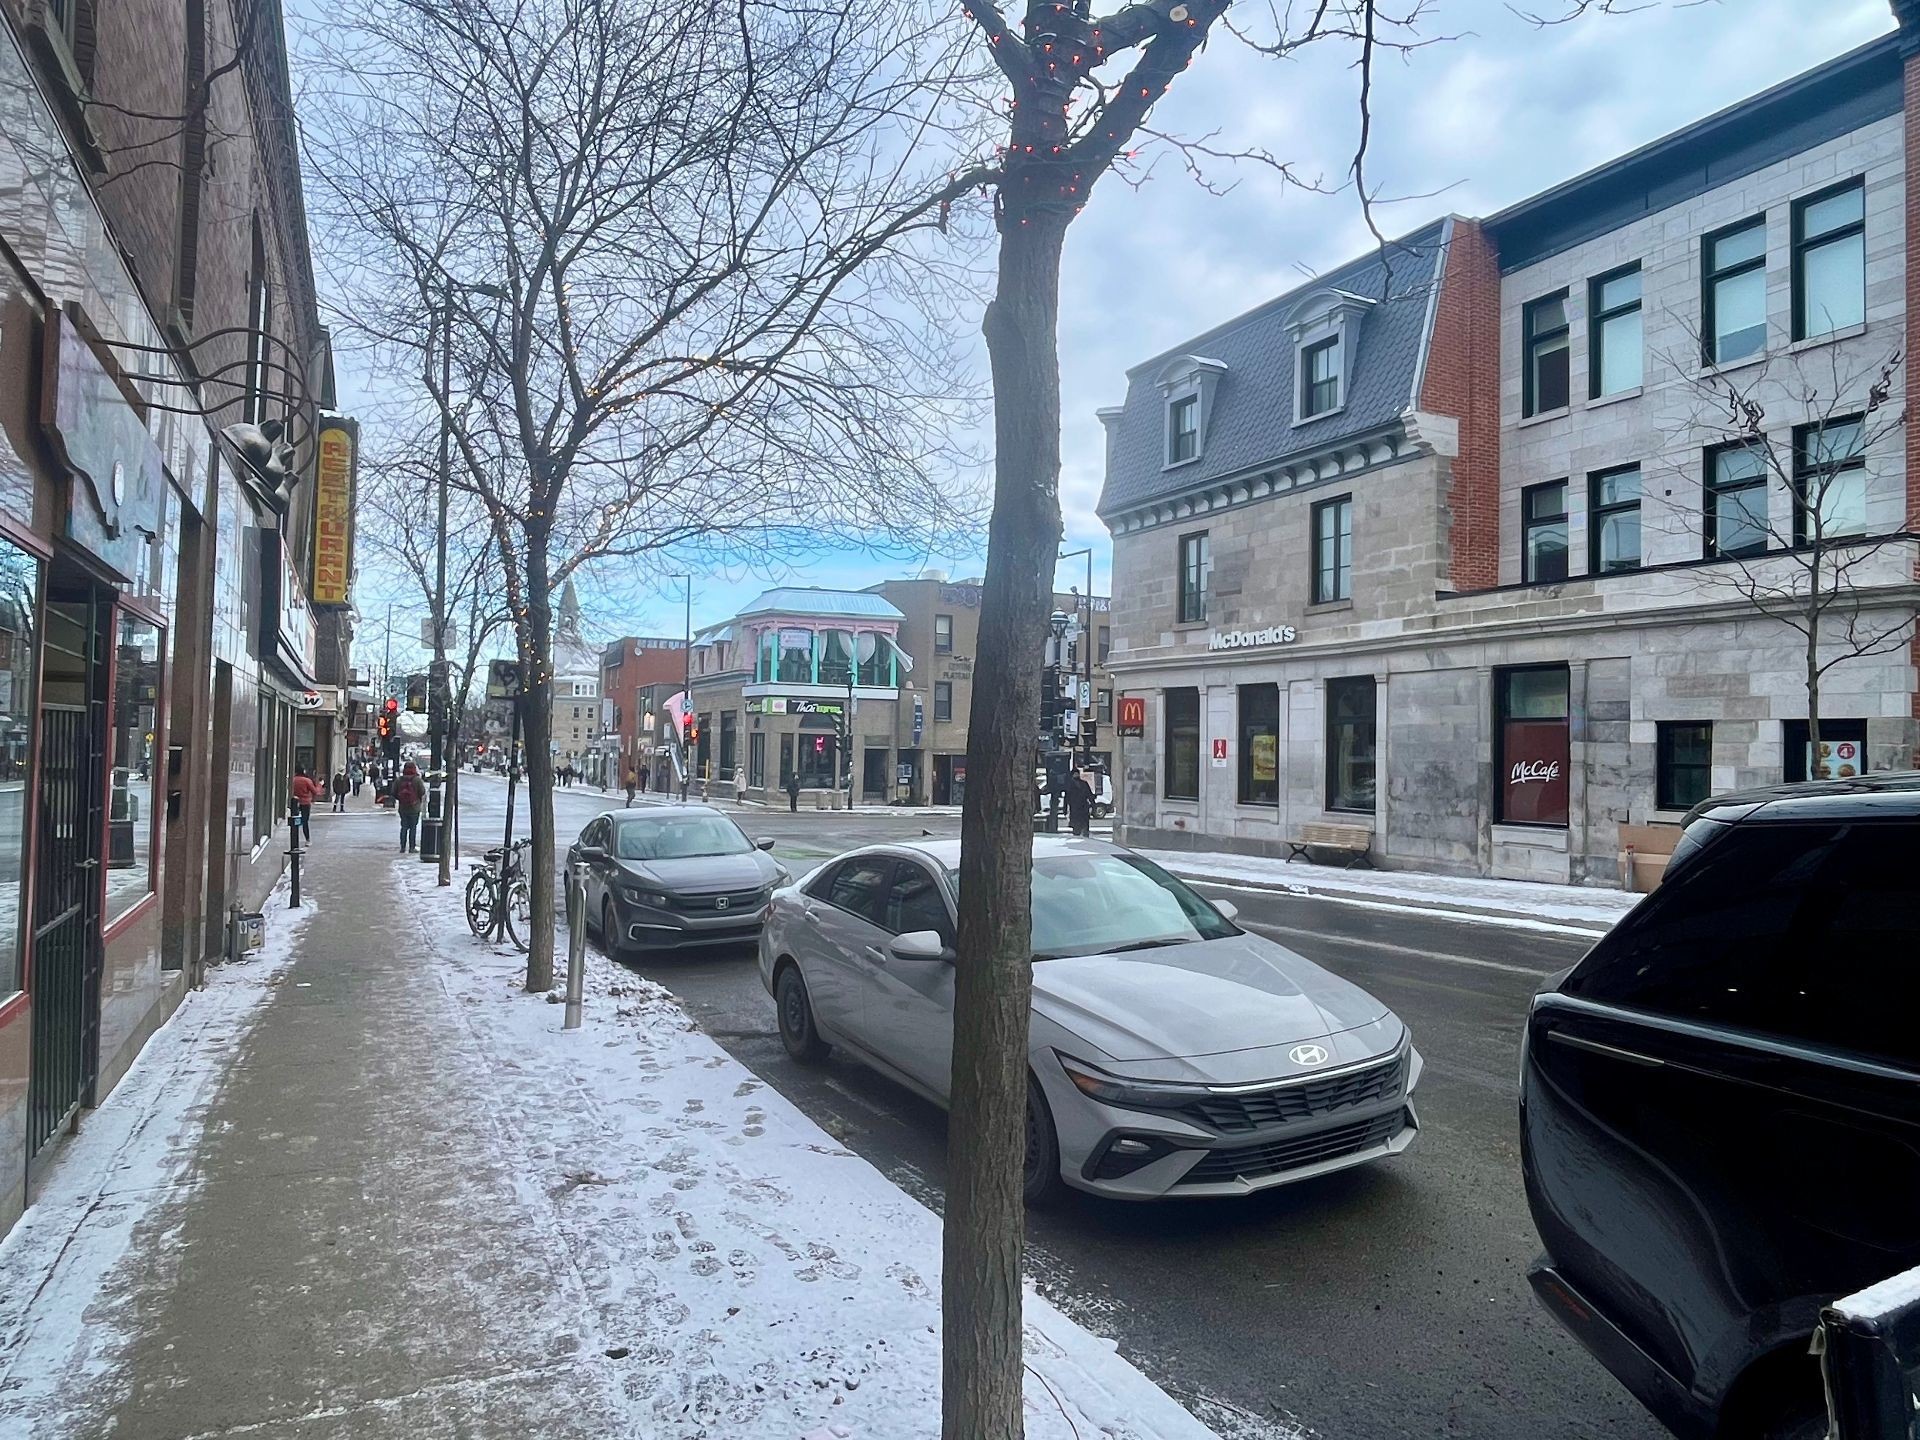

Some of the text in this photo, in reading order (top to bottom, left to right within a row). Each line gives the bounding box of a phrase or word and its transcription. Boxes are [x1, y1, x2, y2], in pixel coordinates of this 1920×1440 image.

[318, 441, 348, 599] RESTAURANT
[1208, 624, 1296, 650] McDonald's
[1510, 760, 1560, 784] McCafé
